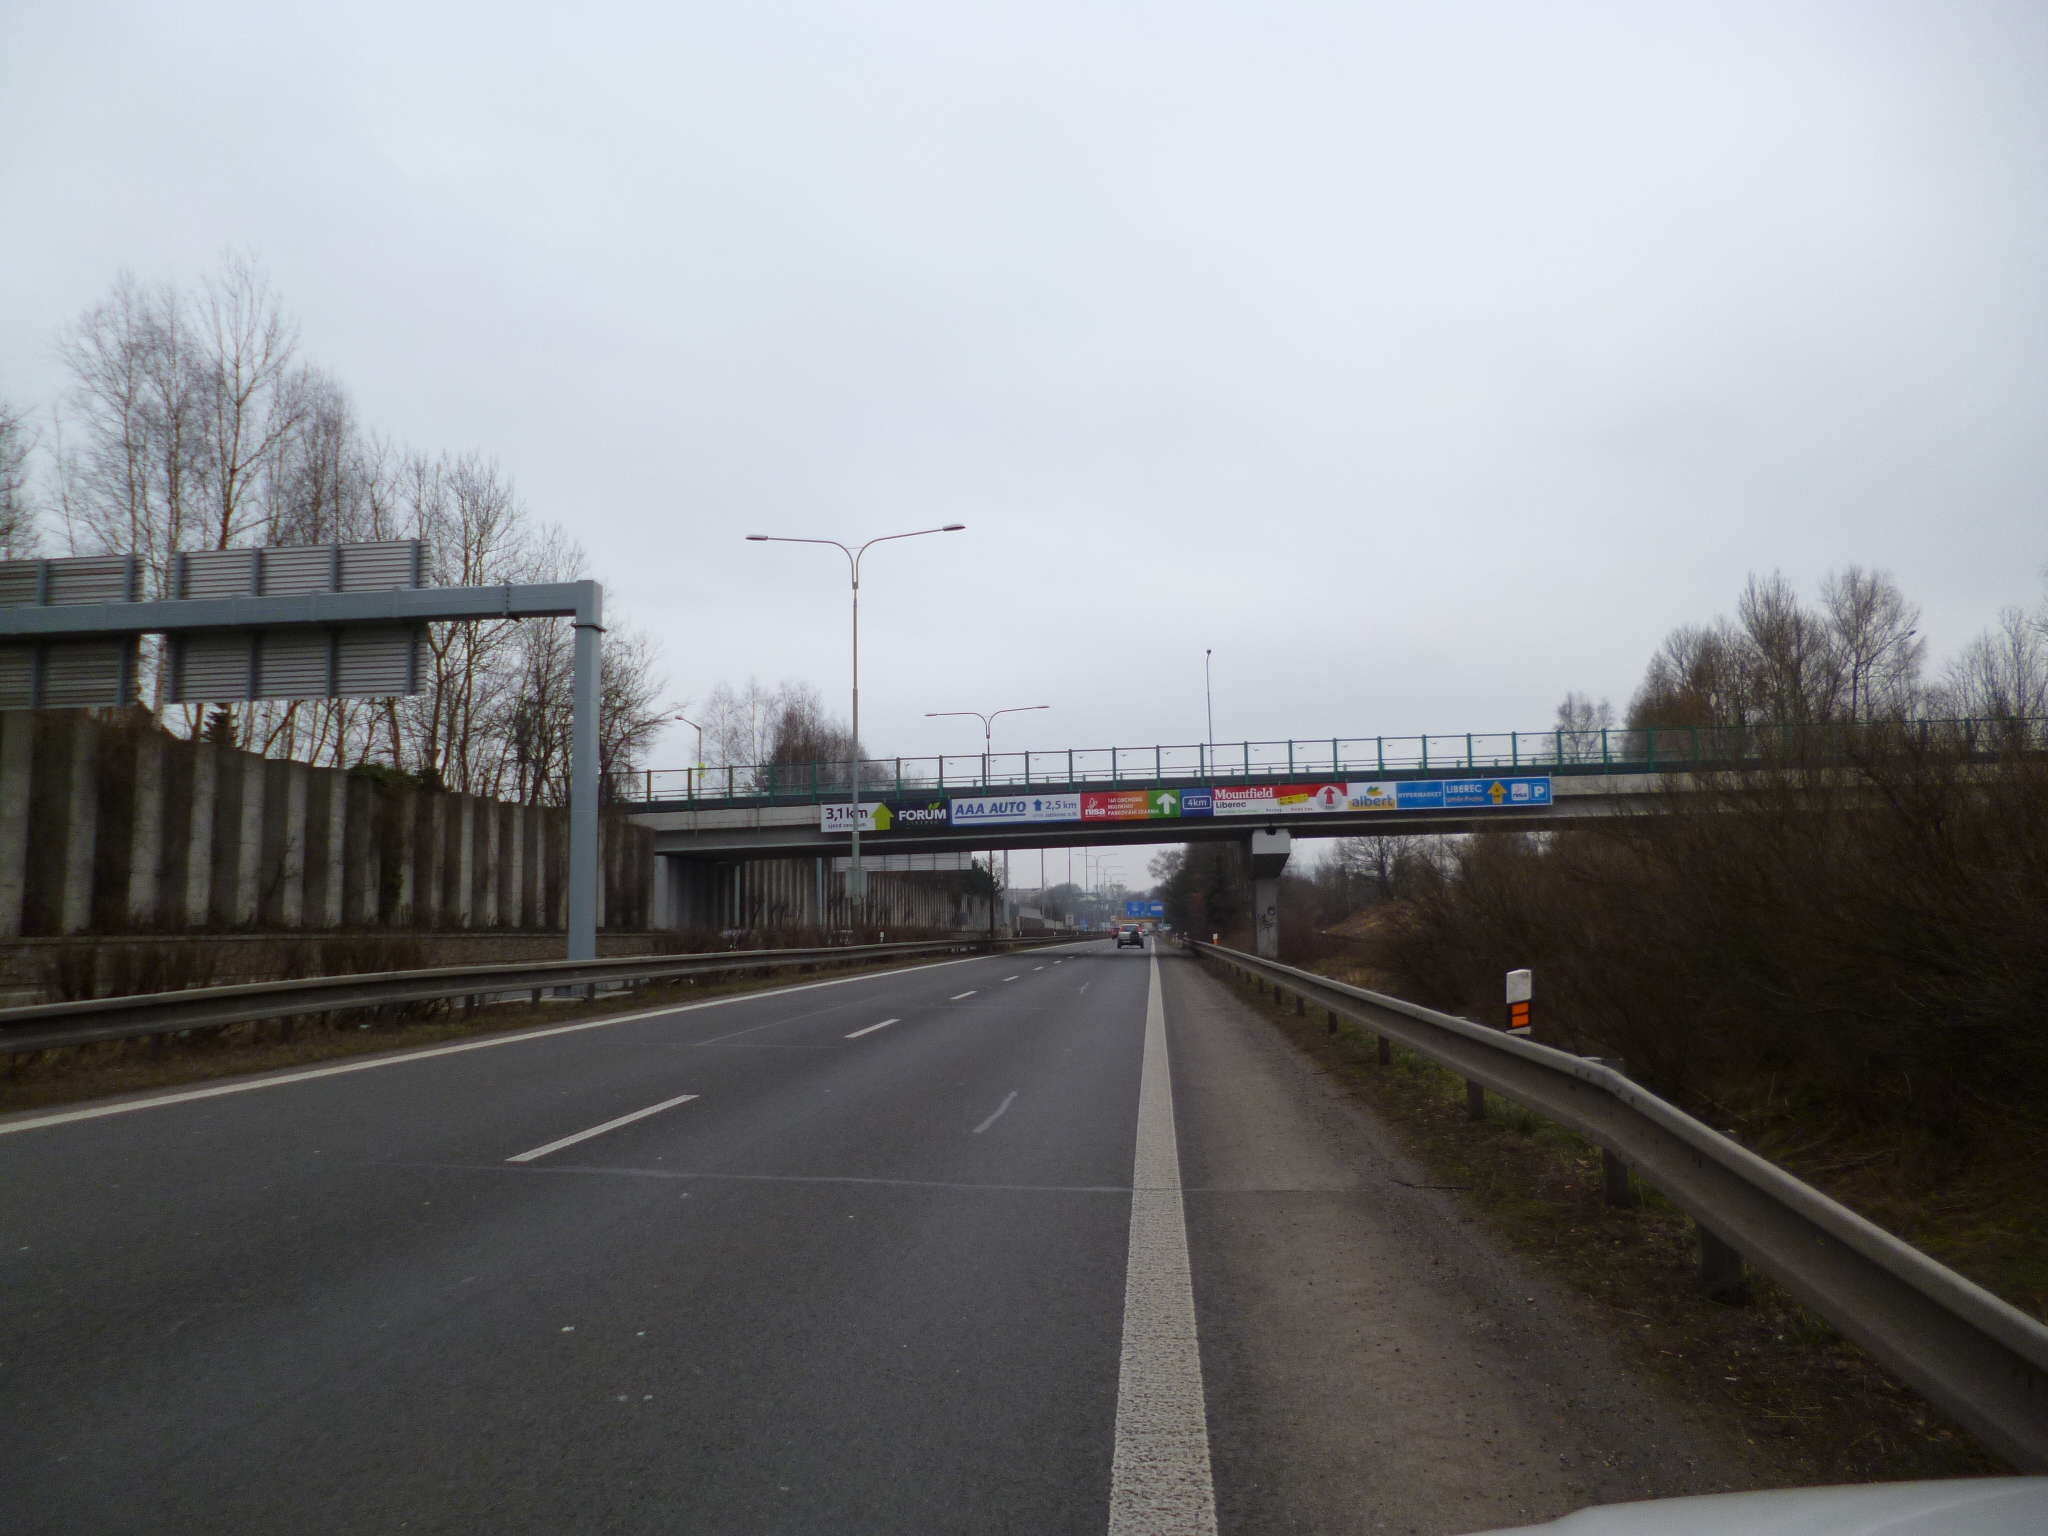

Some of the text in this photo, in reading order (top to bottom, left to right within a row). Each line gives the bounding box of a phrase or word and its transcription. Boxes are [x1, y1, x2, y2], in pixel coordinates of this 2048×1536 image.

[1214, 787, 1273, 800] Mountfield
[1446, 785, 1482, 793] LIBEREC
[1045, 800, 1077, 811] 2,5 km
[1187, 799, 1207, 807] 4km
[1352, 795, 1393, 807] albert
[825, 807, 843, 821] 3,1
[954, 801, 1027, 815] AAA AUTO
[898, 809, 947, 821] FORUM
